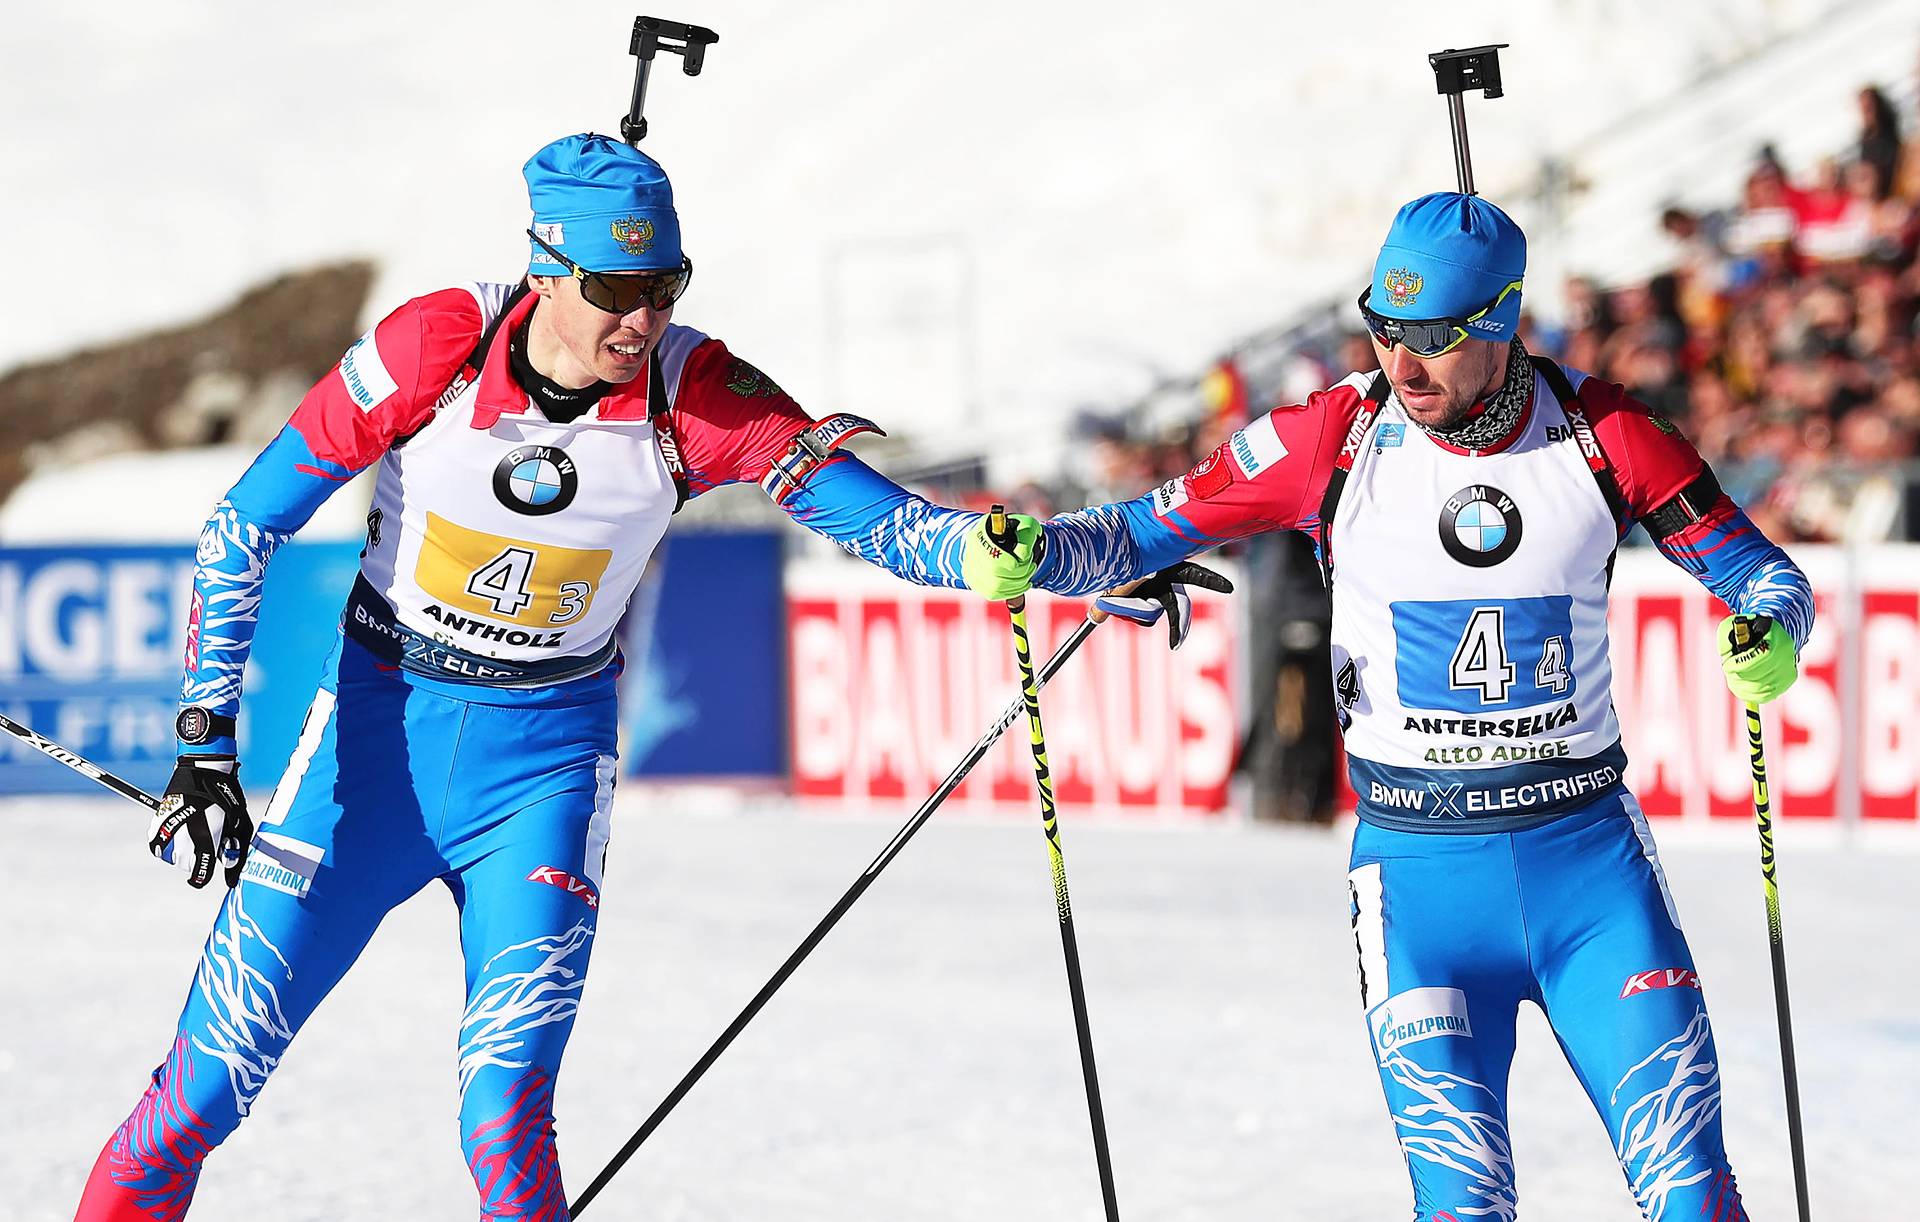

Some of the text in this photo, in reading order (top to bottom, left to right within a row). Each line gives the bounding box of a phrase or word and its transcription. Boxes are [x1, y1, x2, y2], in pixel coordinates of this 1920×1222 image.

[431, 372, 469, 415] SWIX
[656, 428, 685, 474] SWIX
[1341, 408, 1373, 460] SWIX
[1545, 425, 1573, 443] BM
[1568, 409, 1602, 459] SWIX
[506, 446, 577, 476] BMW
[1448, 486, 1514, 514] BMW
[463, 544, 592, 624] 4 3
[422, 603, 567, 649] ANTHOLZ
[1449, 606, 1570, 705] 4 4
[791, 608, 1236, 800] BAUHAUS
[1335, 656, 1361, 709] 4
[1404, 702, 1578, 739] ANTERSELVA
[21, 731, 107, 779] SWIX
[1423, 740, 1570, 764] ALTO ADIGE
[1369, 781, 1424, 811] BMW
[1466, 766, 1619, 812] ELECTRIFIED
[1745, 708, 1779, 889] ONEWAY
[159, 805, 197, 842] KINETIX
[247, 861, 307, 892] GAZPROM
[527, 866, 598, 907] KV+
[1620, 969, 1702, 999] KV+
[1396, 1015, 1468, 1041] GAZPROM
